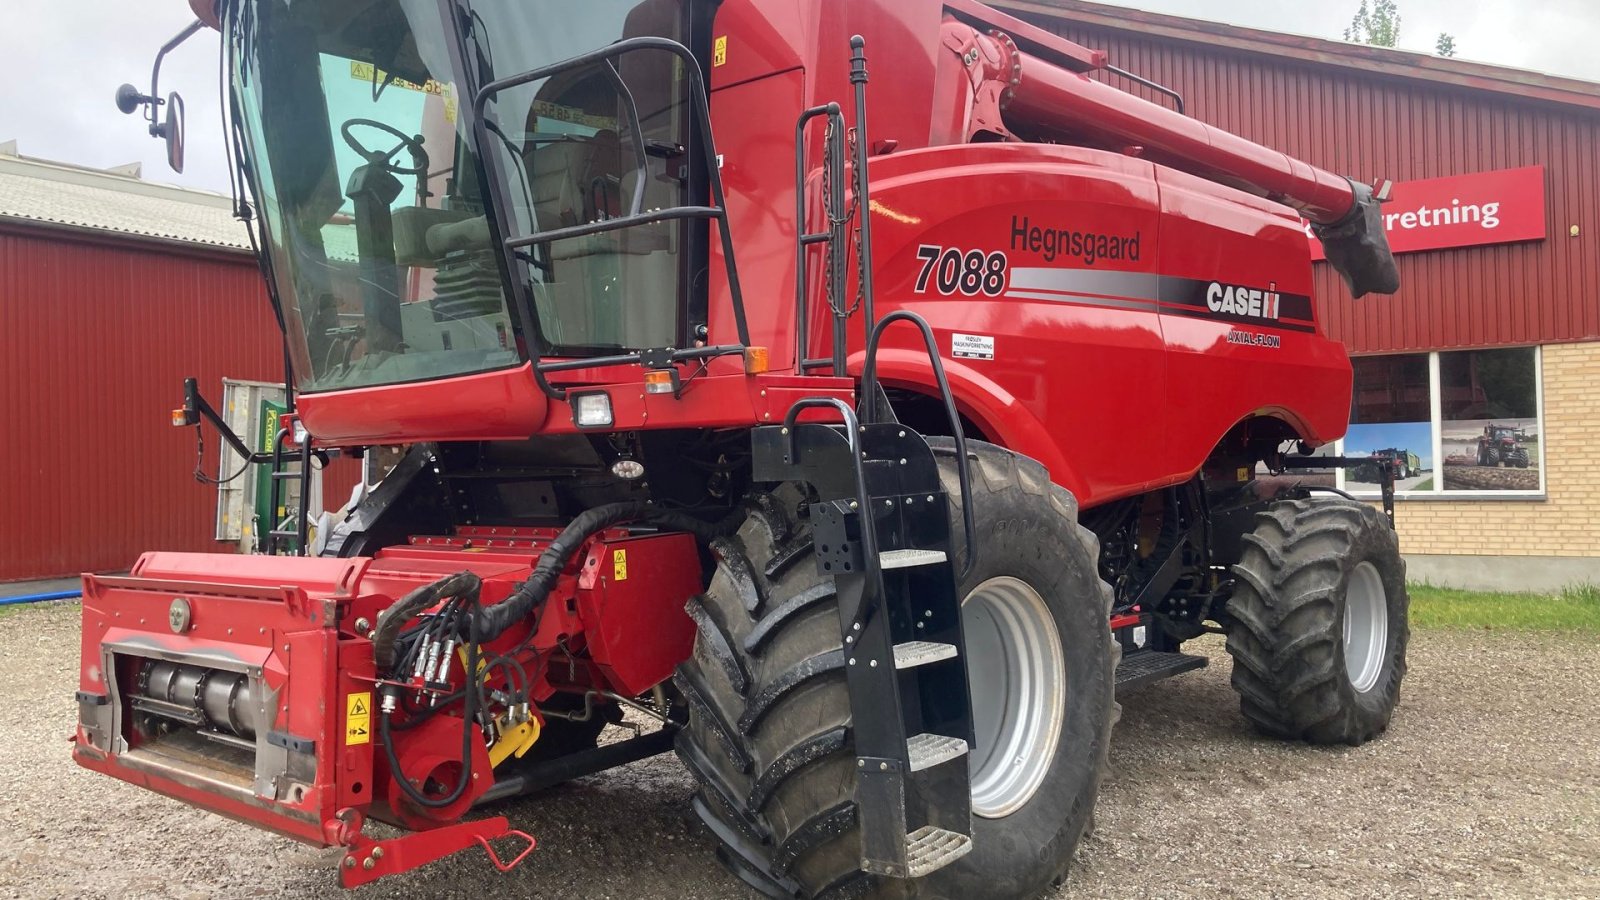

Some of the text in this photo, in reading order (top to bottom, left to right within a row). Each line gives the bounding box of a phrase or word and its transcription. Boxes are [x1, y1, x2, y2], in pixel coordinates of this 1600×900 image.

[1010, 215, 1140, 265] Hegnsgaard
[914, 244, 1007, 297] 7088
[1207, 282, 1261, 317] CASE
[1227, 330, 1281, 348] AXIAL-FLOW
